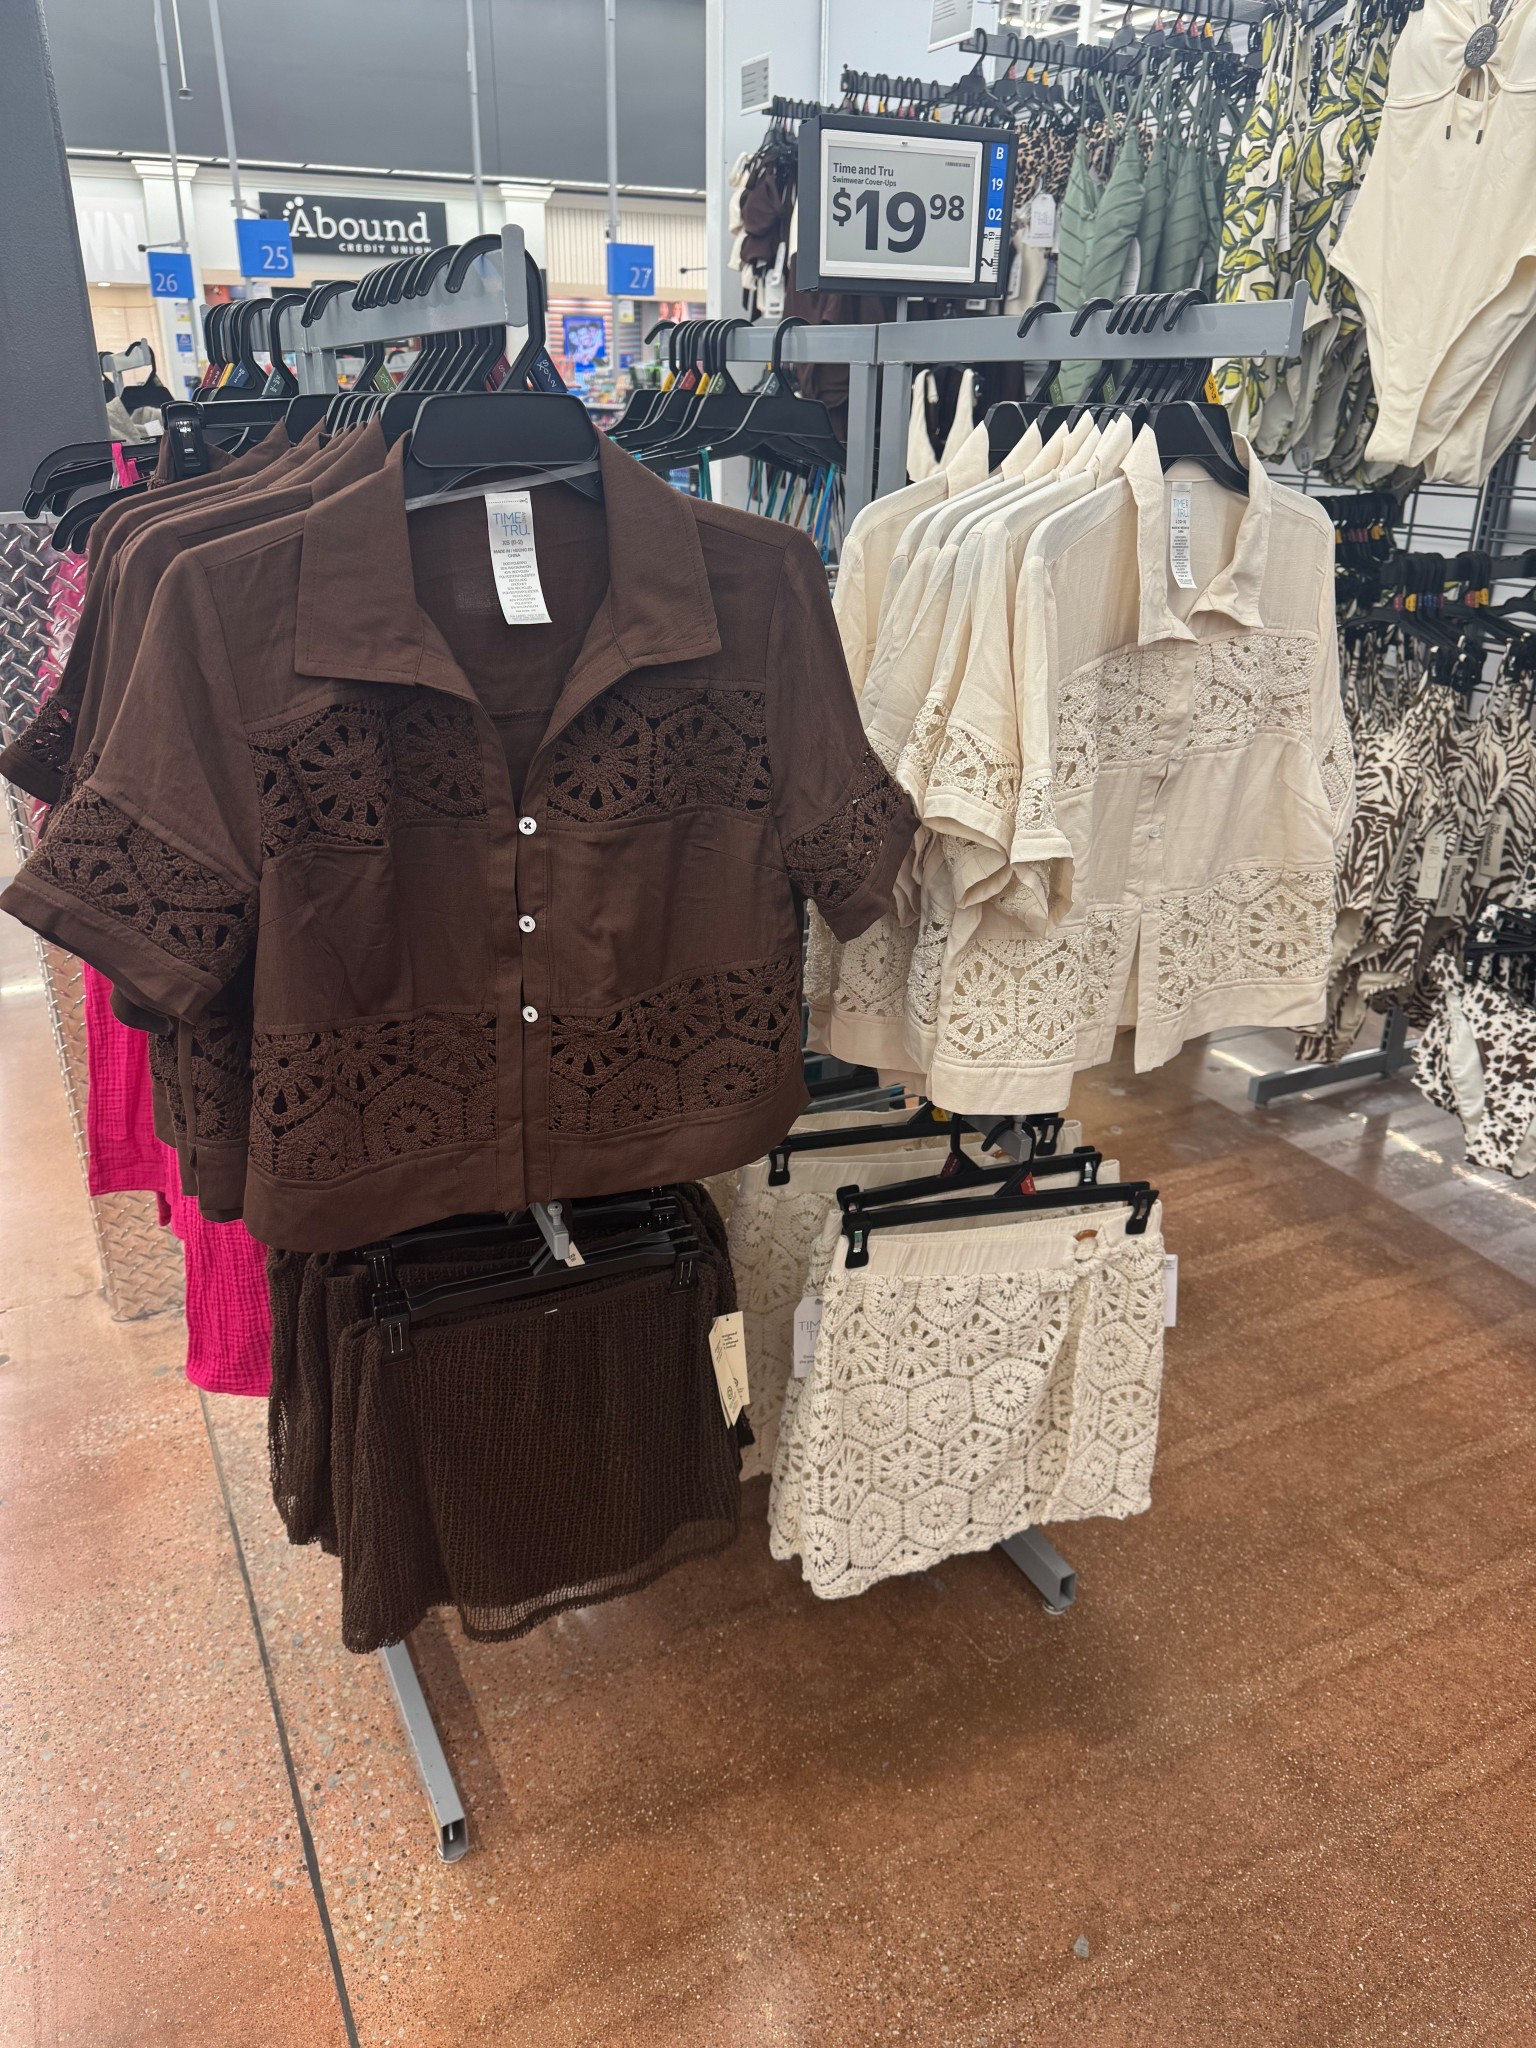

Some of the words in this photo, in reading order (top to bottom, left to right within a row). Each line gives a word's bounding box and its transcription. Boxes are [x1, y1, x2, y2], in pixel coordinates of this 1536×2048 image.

[995, 146, 1005, 160] B
[833, 162, 857, 174] Time
[858, 164, 877, 176] and
[878, 165, 894, 177] Tru
[832, 175, 864, 185] Swimwear
[865, 177, 897, 187] Cover-Ups
[991, 178, 1004, 191] 19
[987, 207, 1002, 221] 02
[288, 205, 432, 244] Abound
[338, 242, 386, 253] CREDIT
[261, 245, 289, 271] 25
[154, 272, 179, 293] 26
[630, 266, 652, 289] 27
[492, 511, 522, 525] TIME
[501, 524, 528, 537] TRU
[797, 1319, 821, 1331] TIM
